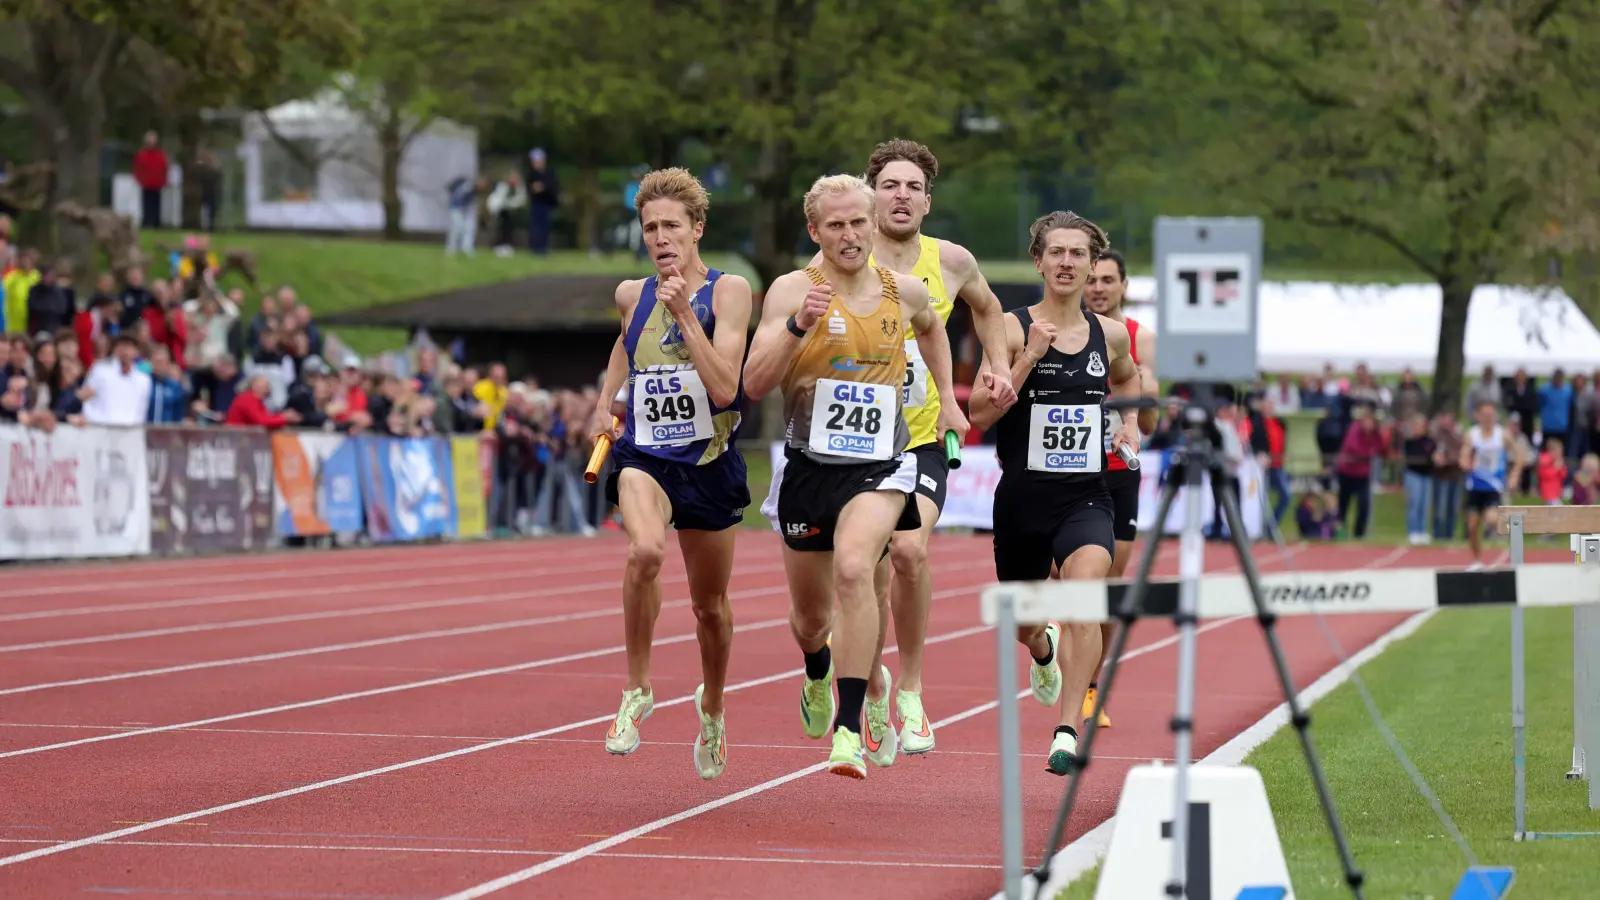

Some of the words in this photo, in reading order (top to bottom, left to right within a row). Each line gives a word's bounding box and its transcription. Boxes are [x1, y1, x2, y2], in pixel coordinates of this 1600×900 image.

[1037, 368, 1056, 376] Leipzig
[644, 395, 696, 422] 349
[826, 403, 882, 435] 248
[668, 425, 693, 435] PLAN
[848, 438, 873, 449] PLAN
[1042, 426, 1091, 451] 587
[786, 522, 808, 534] LSC
